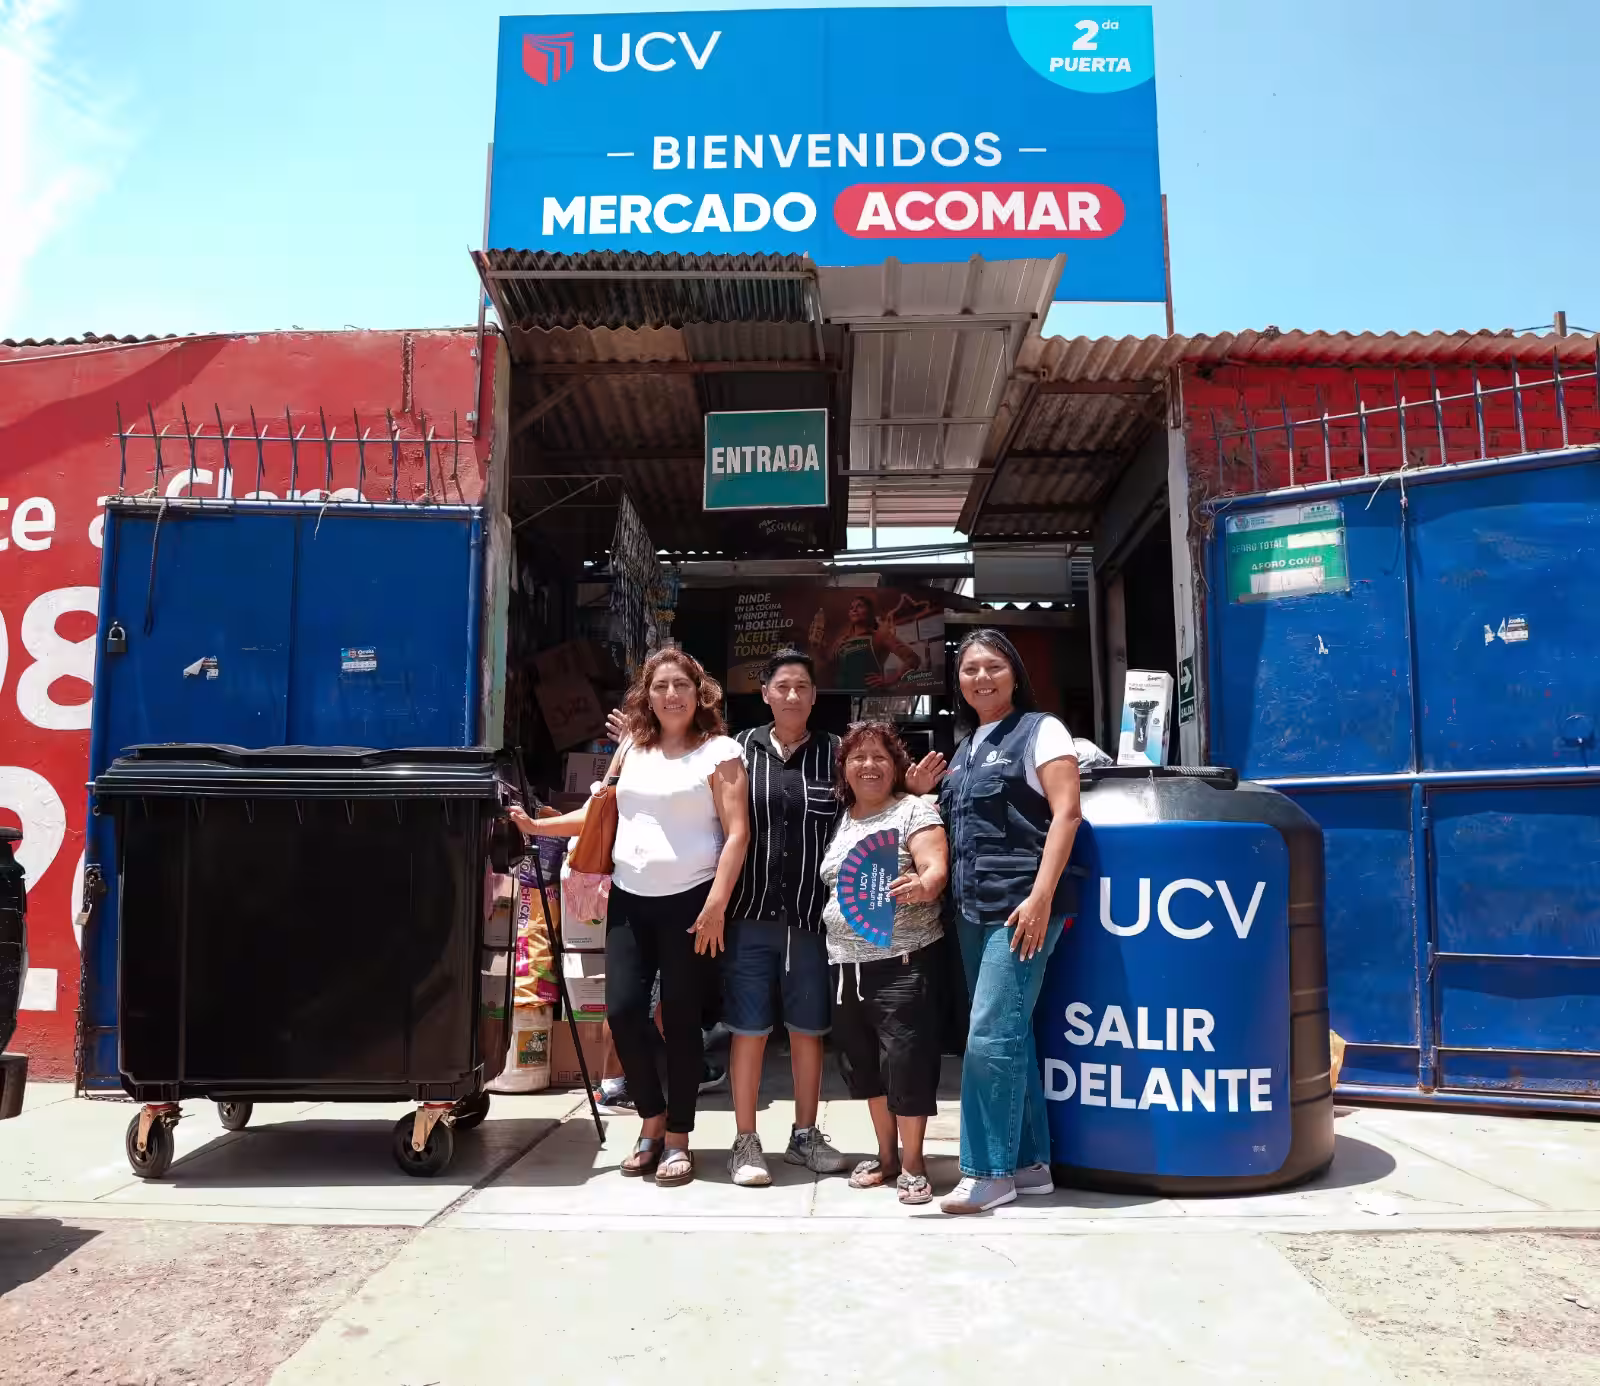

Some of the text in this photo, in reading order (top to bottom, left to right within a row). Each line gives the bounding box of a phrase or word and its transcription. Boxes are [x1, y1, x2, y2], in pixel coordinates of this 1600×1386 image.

[592, 31, 722, 73] UCV
[1049, 57, 1132, 73] PUERTA
[653, 131, 1002, 170] BIENVENIDOS
[541, 190, 1103, 236] MERCADO ACOMAR
[712, 443, 820, 475] ENTRADA
[1260, 539, 1284, 551] TOTAL
[1251, 555, 1322, 571] AFORO COVID
[738, 593, 771, 604] RINDE
[755, 603, 782, 611] COCINA
[743, 611, 769, 620] RINDE
[745, 619, 794, 631] BOLSILLO
[736, 630, 780, 643] ACEITE
[860, 872, 868, 890] UCV
[870, 863, 878, 901] universidad
[1099, 877, 1266, 940] UCV
[1064, 1001, 1215, 1052] SALIR
[1044, 1058, 1273, 1113] DELANTE
